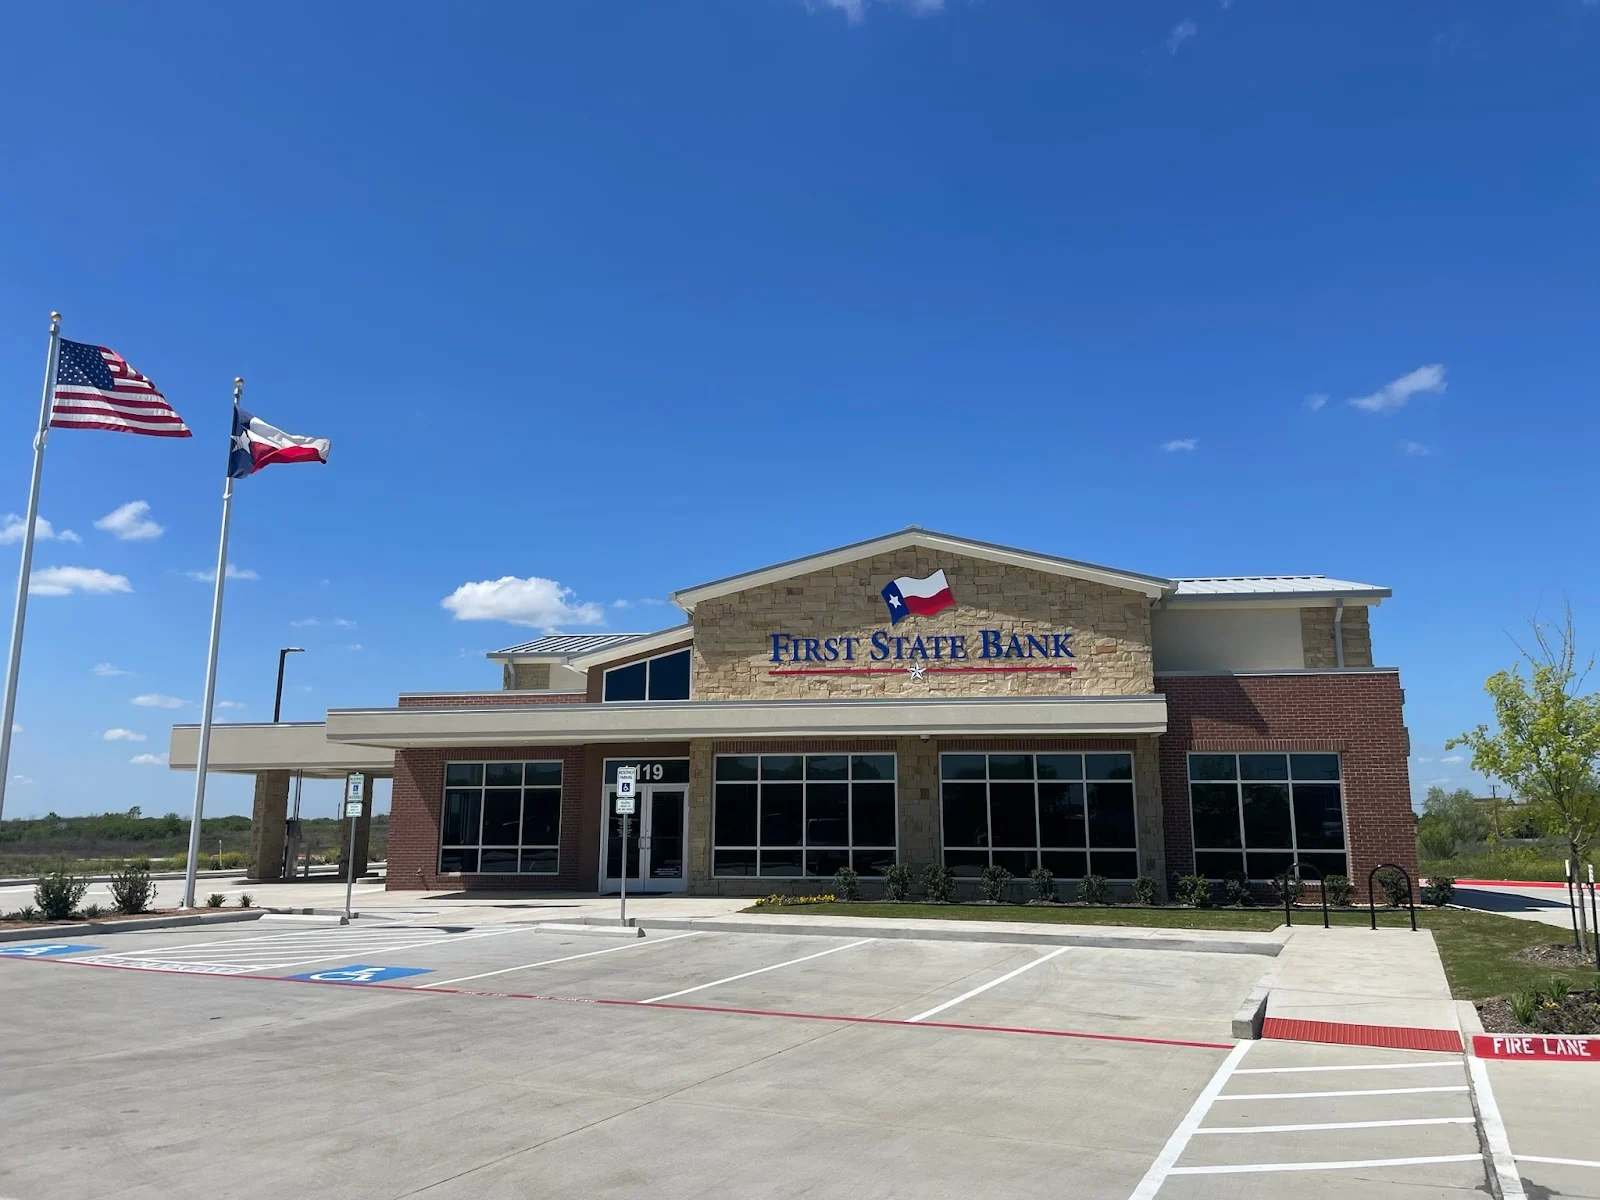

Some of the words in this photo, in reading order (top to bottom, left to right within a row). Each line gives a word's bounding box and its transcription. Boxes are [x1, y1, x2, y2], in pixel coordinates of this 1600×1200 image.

[769, 633, 859, 662] FIRST
[870, 629, 968, 661] STATE
[978, 629, 1076, 660] BANK
[1492, 1037, 1535, 1055] FIRE
[1542, 1038, 1592, 1057] LANE
